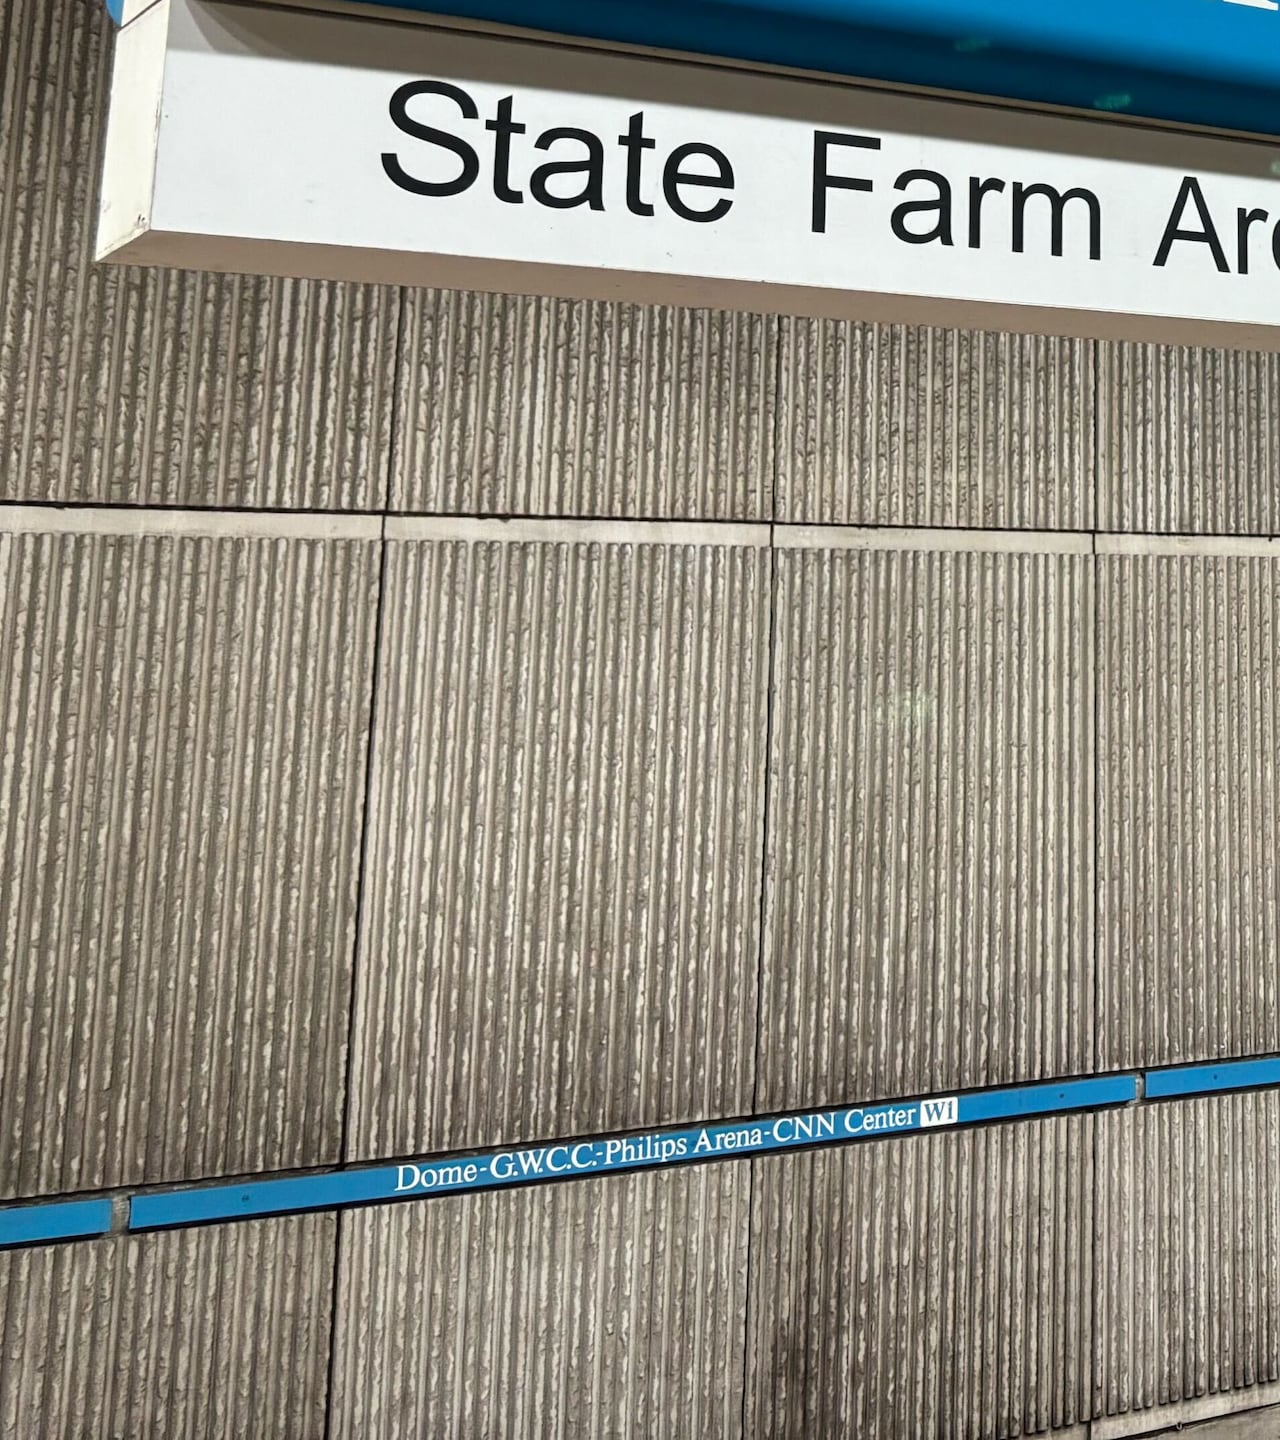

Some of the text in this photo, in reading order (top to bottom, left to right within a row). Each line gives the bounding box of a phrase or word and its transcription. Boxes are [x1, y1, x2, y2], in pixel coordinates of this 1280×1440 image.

[381, 79, 736, 224] State
[810, 129, 1103, 262] Farm
[692, 1111, 837, 1154] Arena-CNN
[843, 1107, 917, 1134] Center
[923, 1099, 954, 1123] W1
